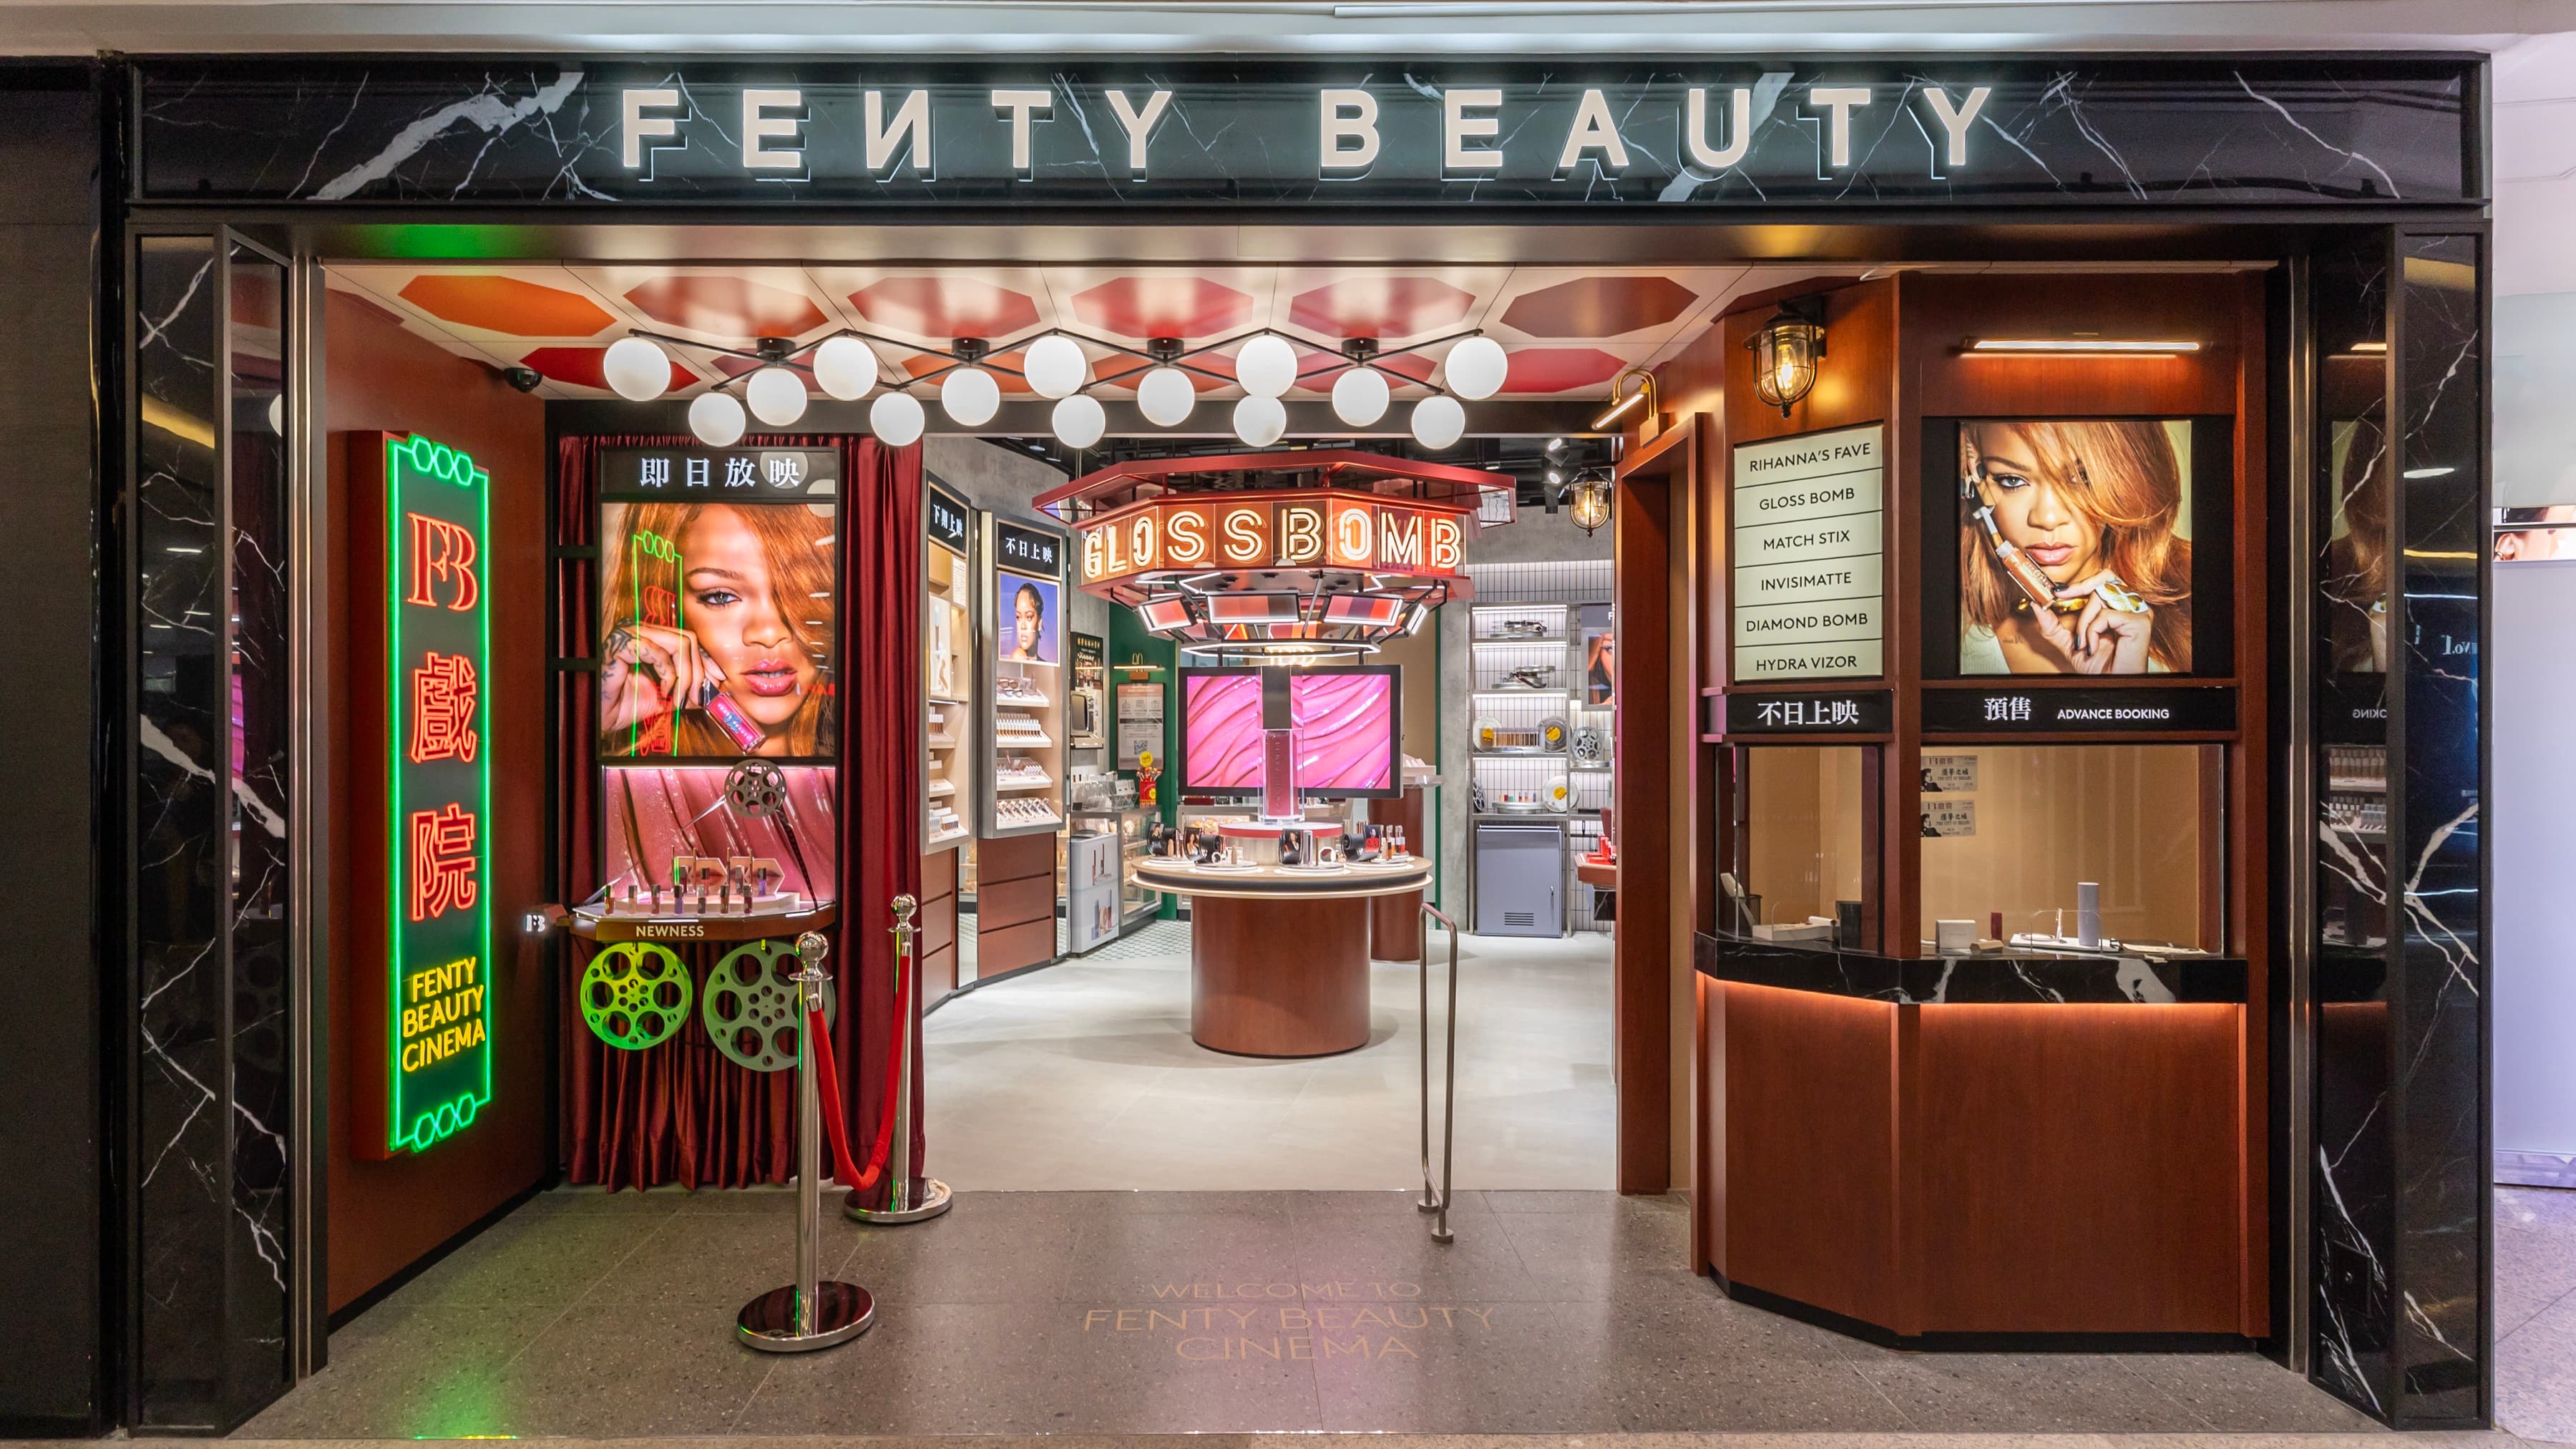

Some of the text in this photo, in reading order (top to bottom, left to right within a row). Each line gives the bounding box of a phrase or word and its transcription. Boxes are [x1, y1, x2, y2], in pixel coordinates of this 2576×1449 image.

[1319, 88, 1993, 169] BEAUTY
[1834, 442, 1871, 460] FAVE
[640, 455, 803, 489] 即日放映
[1759, 487, 1855, 510] GLOSS BOMB
[1005, 537, 1053, 565] 不日上映
[1763, 530, 1851, 550] MATCH STIX
[1760, 572, 1853, 591] INVISIMATTE
[1745, 613, 1869, 633] DIAMOND BOMB
[1755, 655, 1858, 672] HYDRA VIZOR
[1757, 700, 1859, 726] 不日上映
[1984, 696, 2031, 721] 預售
[2057, 708, 2170, 720] ADVANCE BOOKING
[410, 651, 477, 922] 戲院
[635, 925, 705, 937] NEWNESS
[412, 956, 477, 1003] FENTY
[403, 984, 484, 1038] BEAUTY
[402, 1018, 486, 1072] CINEMA
[1151, 1282, 1422, 1299] WELCOME TO
[1084, 1307, 1496, 1331] FENTY BEAUTY
[1176, 1335, 1419, 1360] CINEMA
